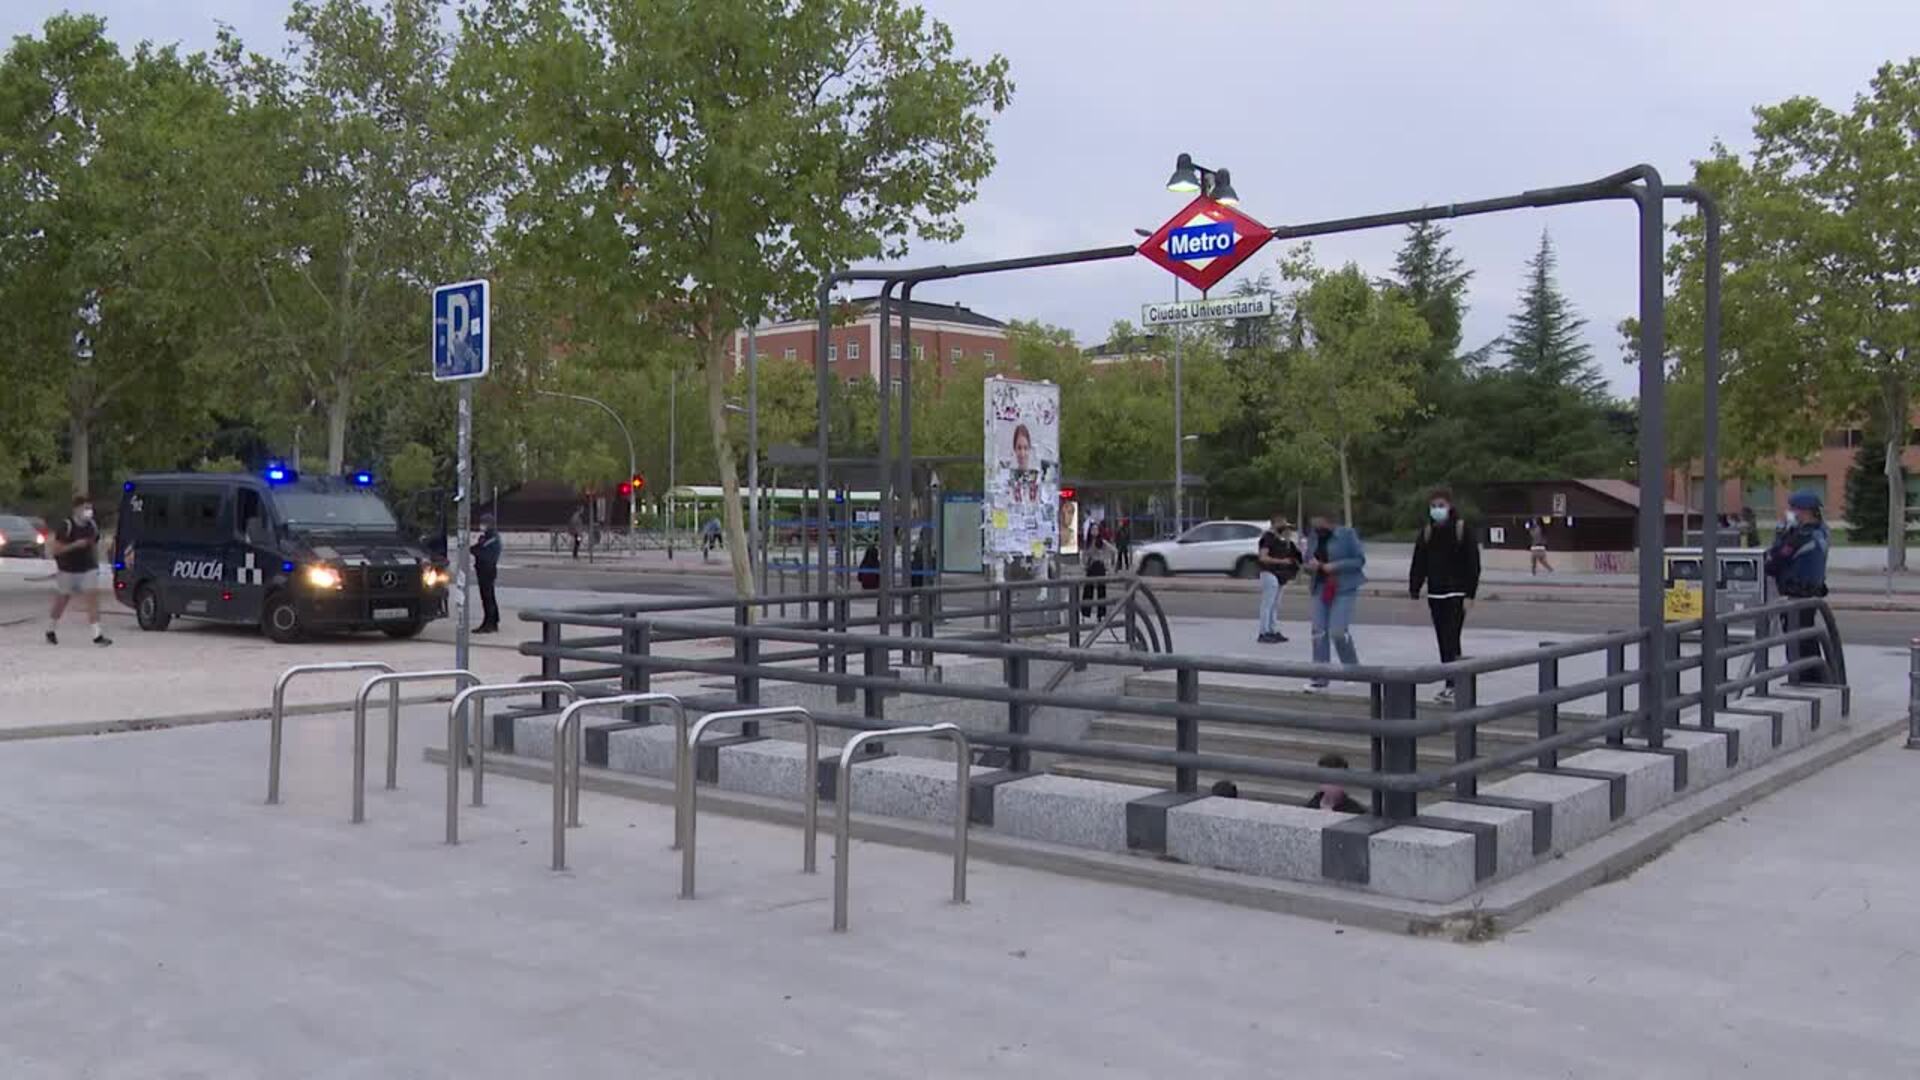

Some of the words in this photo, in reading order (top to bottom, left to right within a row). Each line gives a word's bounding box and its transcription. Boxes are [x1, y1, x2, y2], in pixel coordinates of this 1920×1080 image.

[1171, 233, 1230, 254] Metro
[1149, 303, 1188, 321] Ciudad
[1191, 300, 1263, 317] Universitaria
[173, 560, 223, 580] POLICÍA
